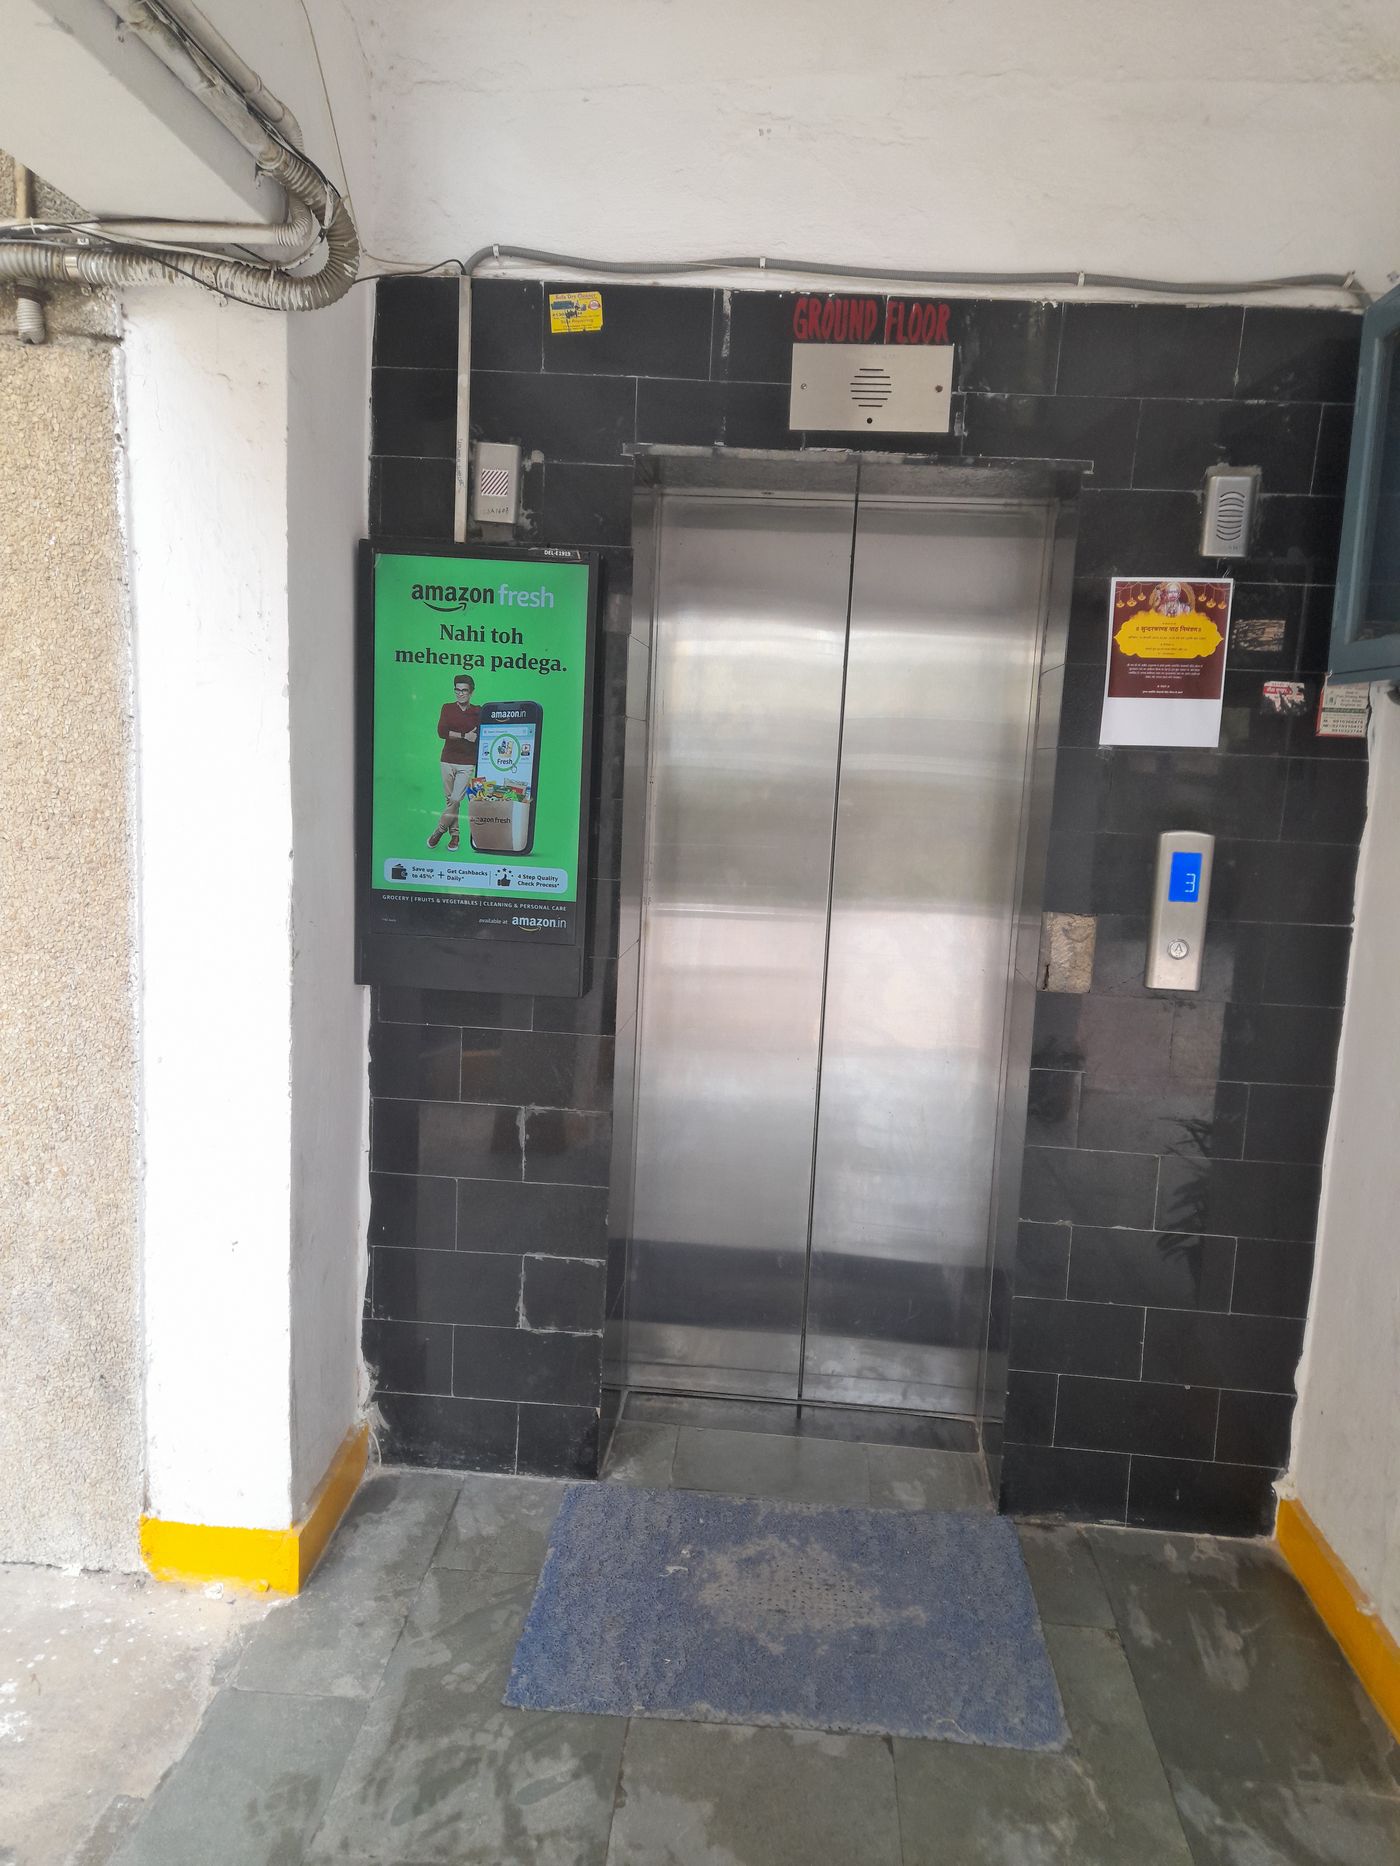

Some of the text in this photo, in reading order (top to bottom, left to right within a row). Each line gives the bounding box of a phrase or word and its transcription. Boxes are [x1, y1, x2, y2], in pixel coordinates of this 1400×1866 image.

[793, 297, 952, 344] GROUND FLOOR
[411, 583, 554, 608] amazon fresh
[440, 623, 524, 644] Nahi toh
[395, 647, 567, 675] mehenga padega.
[490, 710, 527, 719] amazon.in
[494, 816, 511, 824] fresh
[1185, 873, 1196, 893] 3
[442, 898, 478, 906] VEGETABLES
[511, 916, 567, 928] amazon.in
